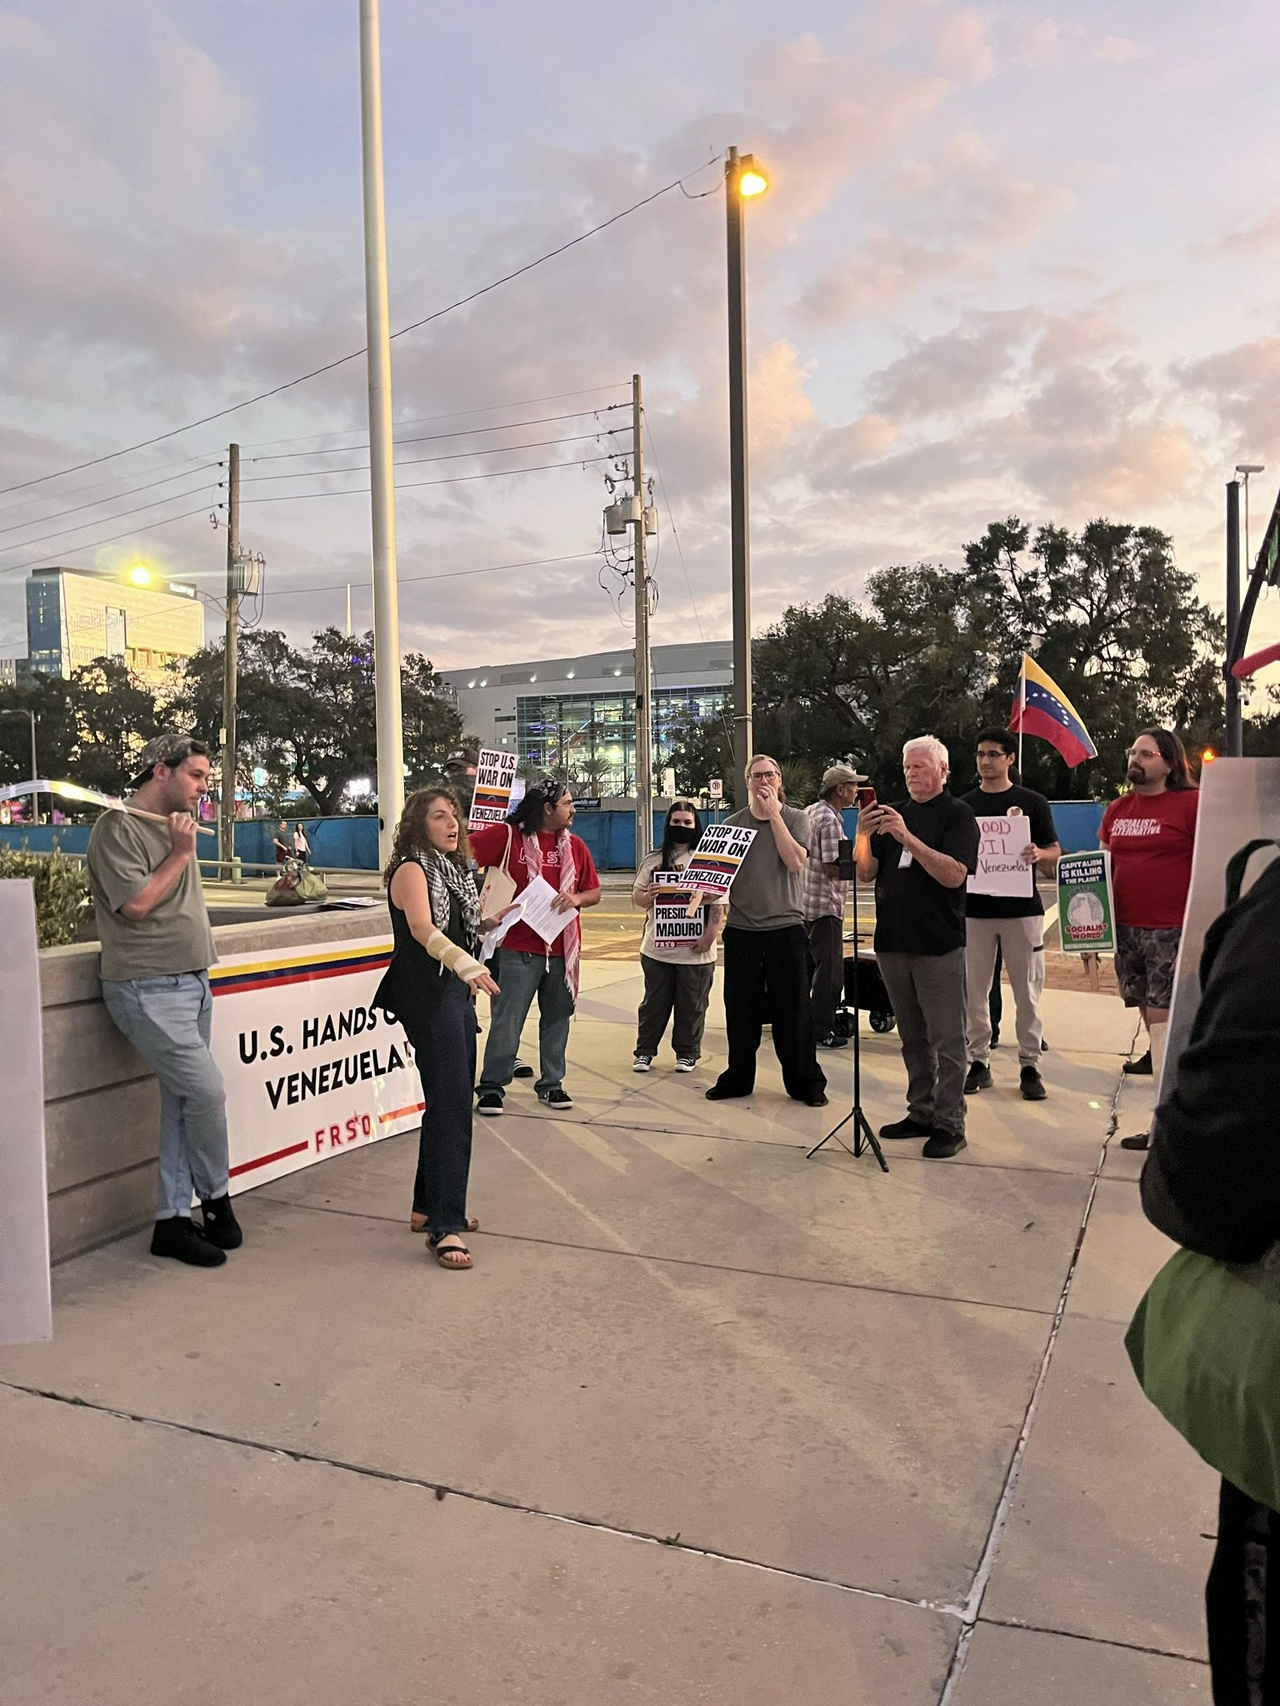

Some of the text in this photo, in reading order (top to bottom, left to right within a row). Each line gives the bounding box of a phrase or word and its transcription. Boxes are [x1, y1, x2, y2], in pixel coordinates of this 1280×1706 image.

[480, 752, 499, 767] STOP
[500, 755, 516, 770] U.S.
[478, 768, 514, 788] WAR ON
[981, 820, 1012, 835] OOD
[1113, 818, 1157, 828] SOCIALIST
[704, 826, 752, 843] STOP U.S.
[698, 839, 748, 857] WAR ON
[980, 859, 1029, 874] Venezuela!
[1060, 859, 1103, 870] CAPITALISM
[655, 873, 683, 884] FR
[683, 870, 732, 887] VENEZUELA
[1061, 867, 1103, 878] IS KILLING
[656, 907, 703, 920] PRESIDT
[656, 922, 703, 937] MADURO
[239, 1006, 377, 1064] U.S. HANDS
[315, 1113, 371, 1153] FRSO
